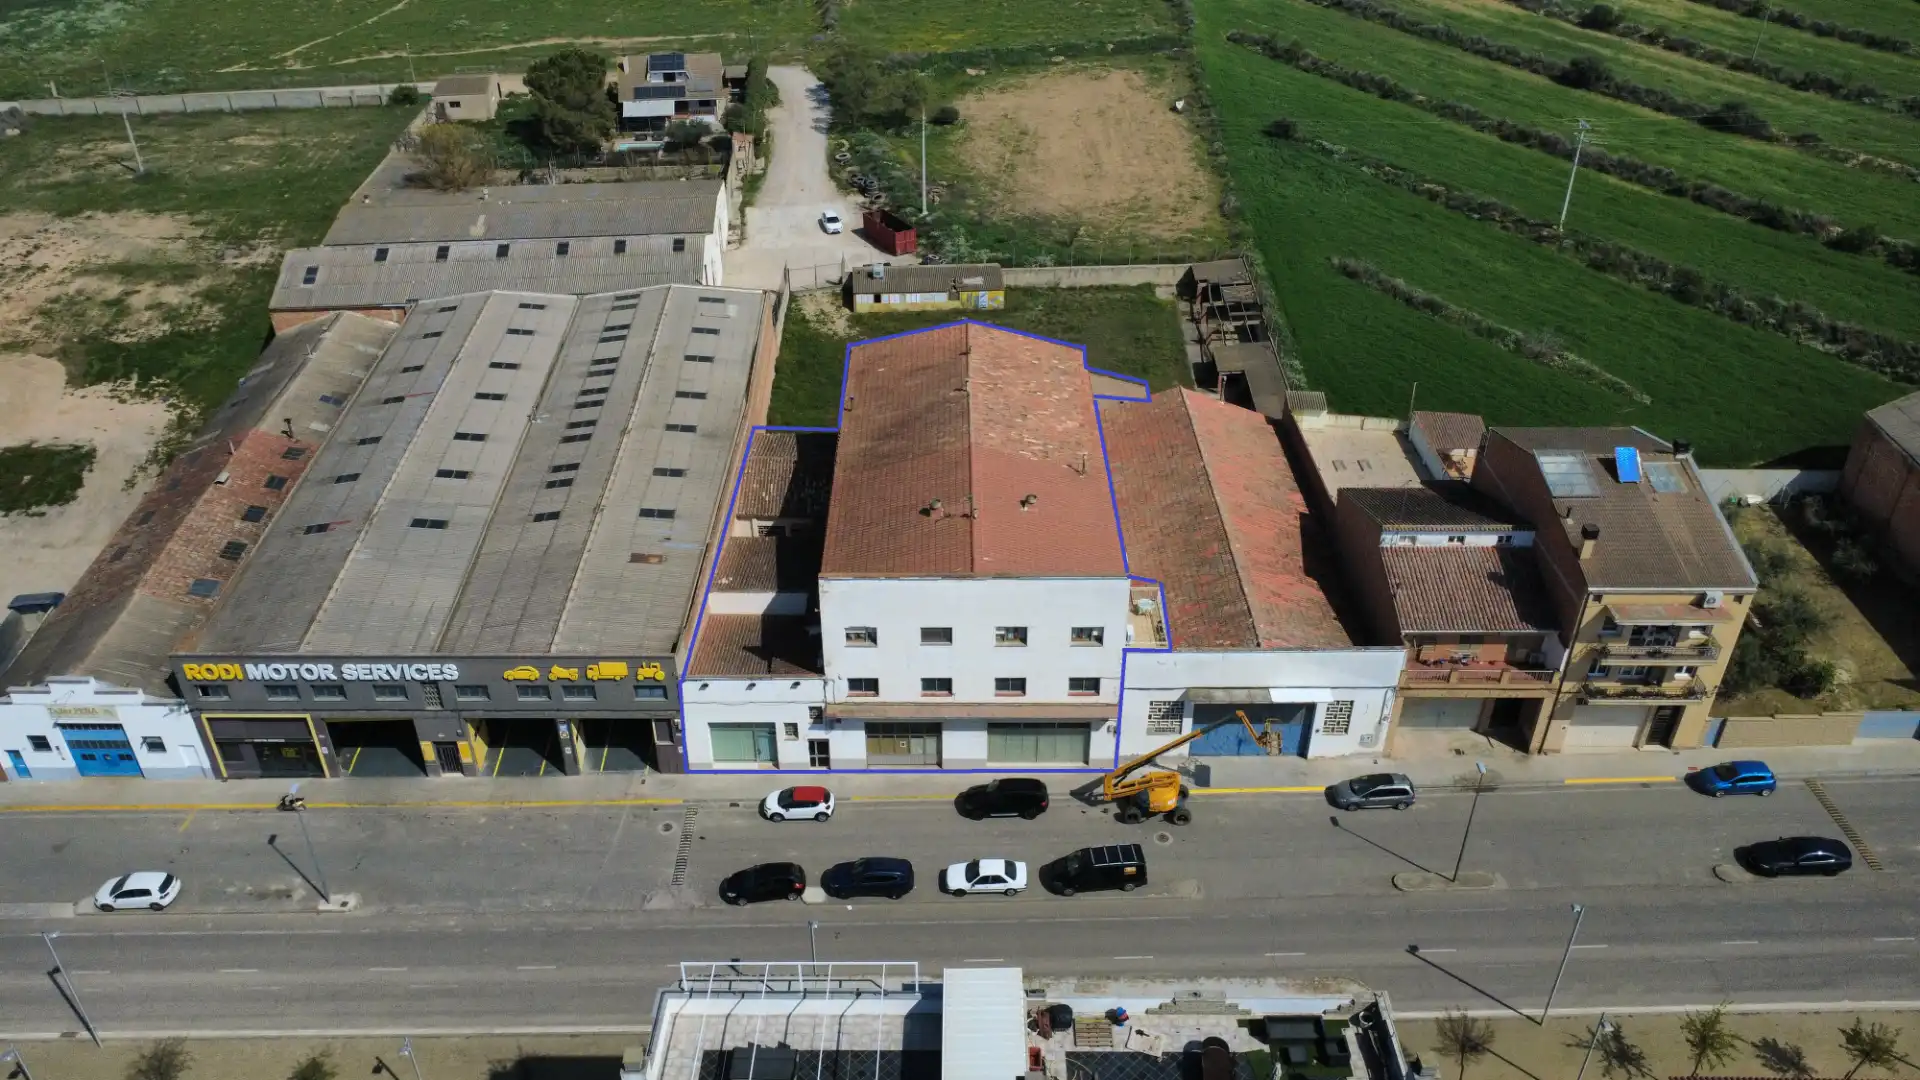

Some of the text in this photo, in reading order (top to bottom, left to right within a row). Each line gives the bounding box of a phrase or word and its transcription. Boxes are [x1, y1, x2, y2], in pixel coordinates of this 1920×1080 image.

[183, 663, 459, 681] RODI MOTOR SERVICES
